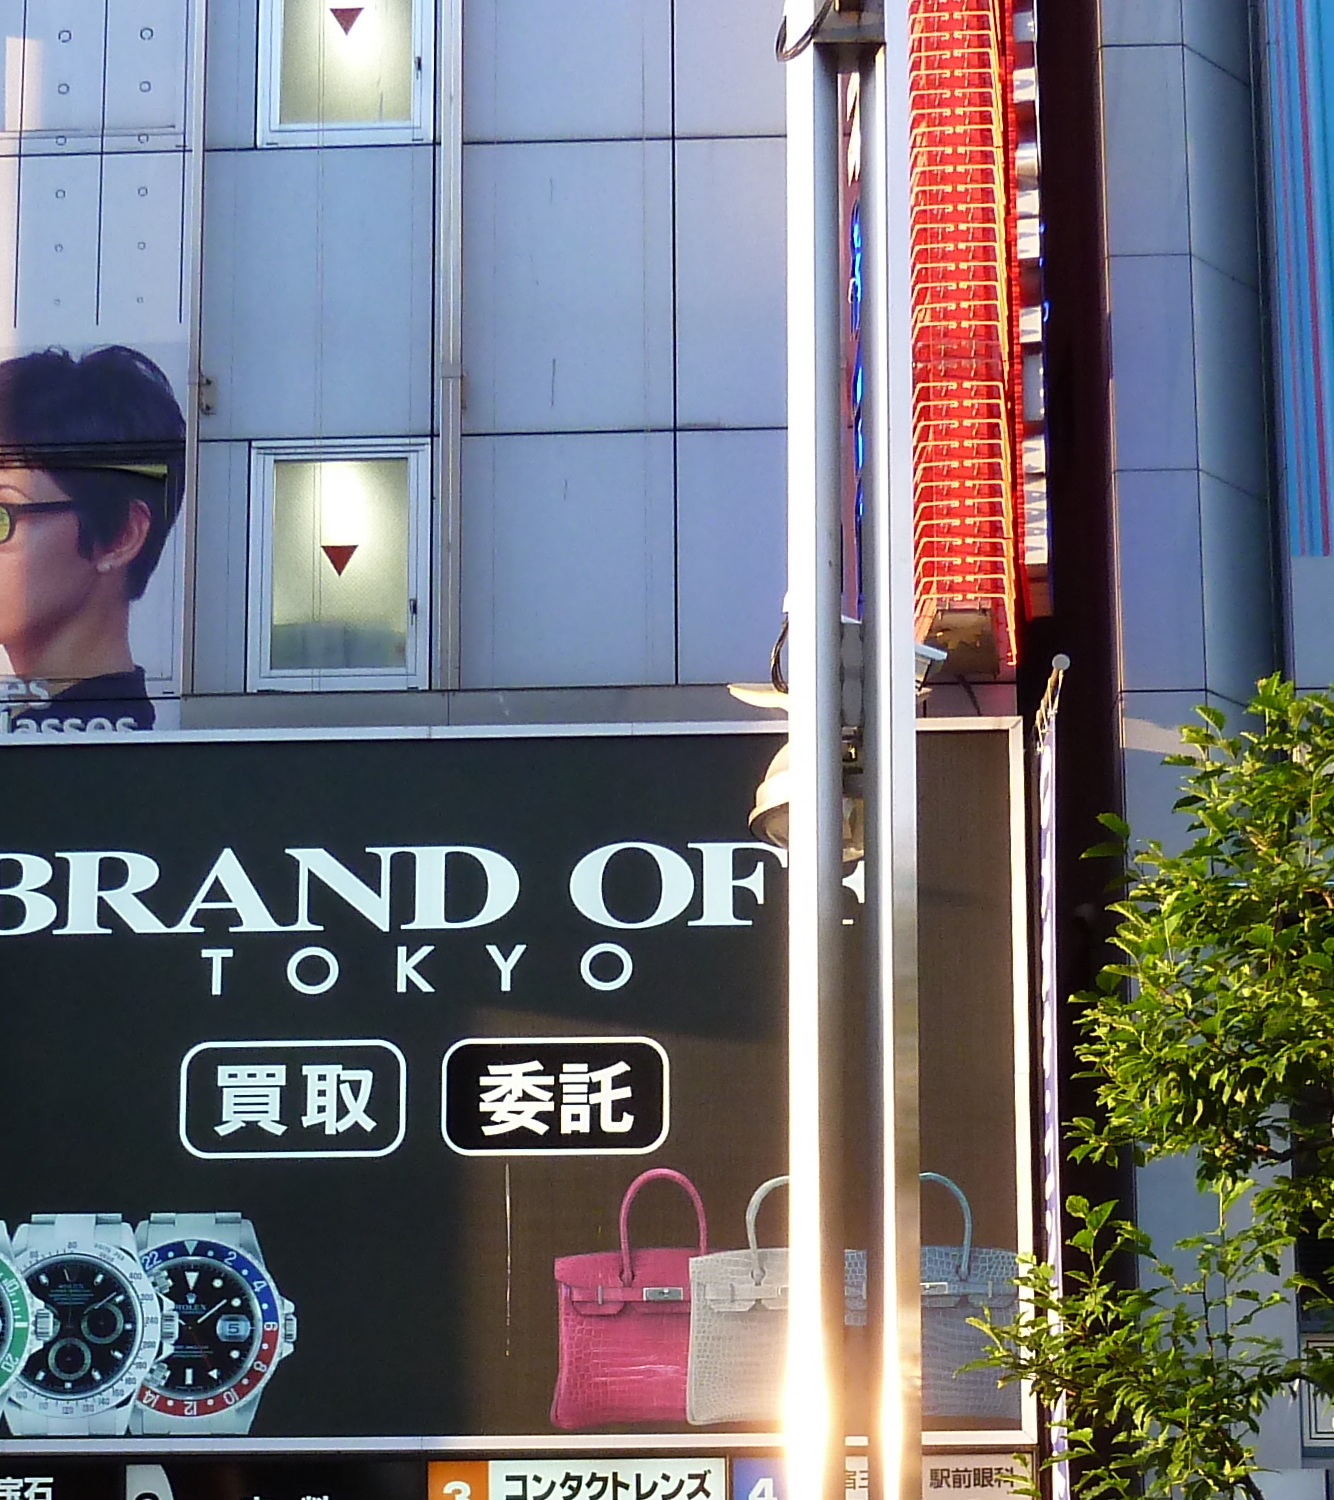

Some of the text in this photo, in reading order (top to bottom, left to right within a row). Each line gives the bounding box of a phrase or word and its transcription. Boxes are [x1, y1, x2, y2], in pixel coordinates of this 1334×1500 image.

[569, 841, 866, 930] OF
[201, 943, 634, 996] TOKYO
[216, 1061, 635, 1137] 買取 委託
[142, 1251, 162, 1270] 22
[224, 1251, 237, 1265] 2
[253, 1280, 266, 1292] 4
[229, 1324, 239, 1333] 5
[254, 1361, 267, 1372] 8
[184, 1401, 197, 1416] 12
